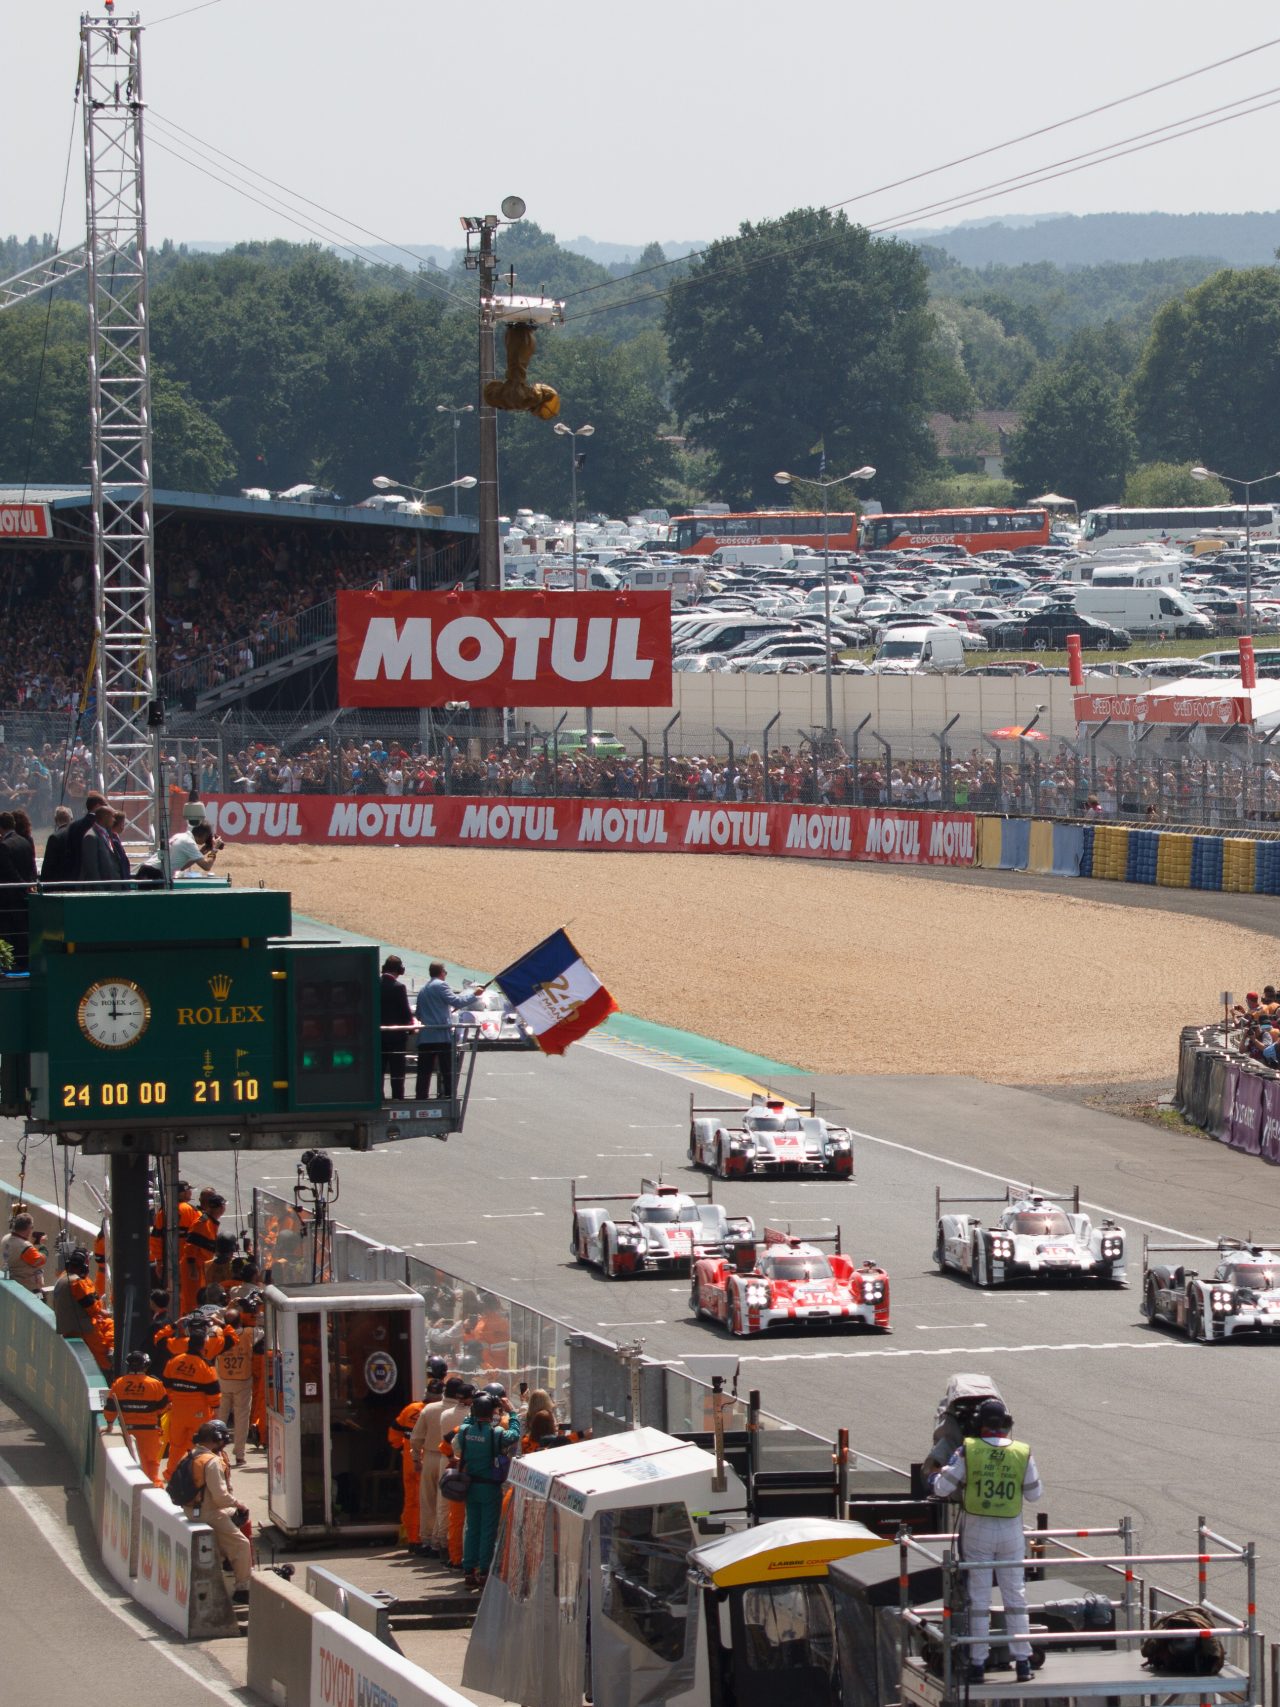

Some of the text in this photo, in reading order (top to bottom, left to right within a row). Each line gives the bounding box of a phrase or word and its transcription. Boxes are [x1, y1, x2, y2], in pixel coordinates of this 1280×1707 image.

[0, 509, 38, 532] OTUL
[715, 537, 761, 545] CROSSKEYS
[354, 616, 654, 681] MOTUL
[1092, 701, 1111, 716] SPEED
[1112, 701, 1130, 716] FOOD
[1173, 702, 1192, 717] SPEED
[1194, 702, 1213, 717] FOOD
[328, 803, 437, 837] MOTUL
[459, 804, 558, 841] MOTUL
[578, 807, 668, 843] MOTUL
[684, 810, 770, 846] MOTUL
[786, 813, 852, 851] MOTUL
[866, 817, 921, 855] MOTUL
[929, 821, 973, 857] MOTUL
[177, 1005, 265, 1025] ROLEX
[63, 1079, 258, 1107] 24 00 00 21 10
[673, 1231, 690, 1239] 8
[223, 1357, 244, 1370] 327
[975, 1479, 1016, 1500] 1340
[320, 1646, 355, 1707] TOYOTA
